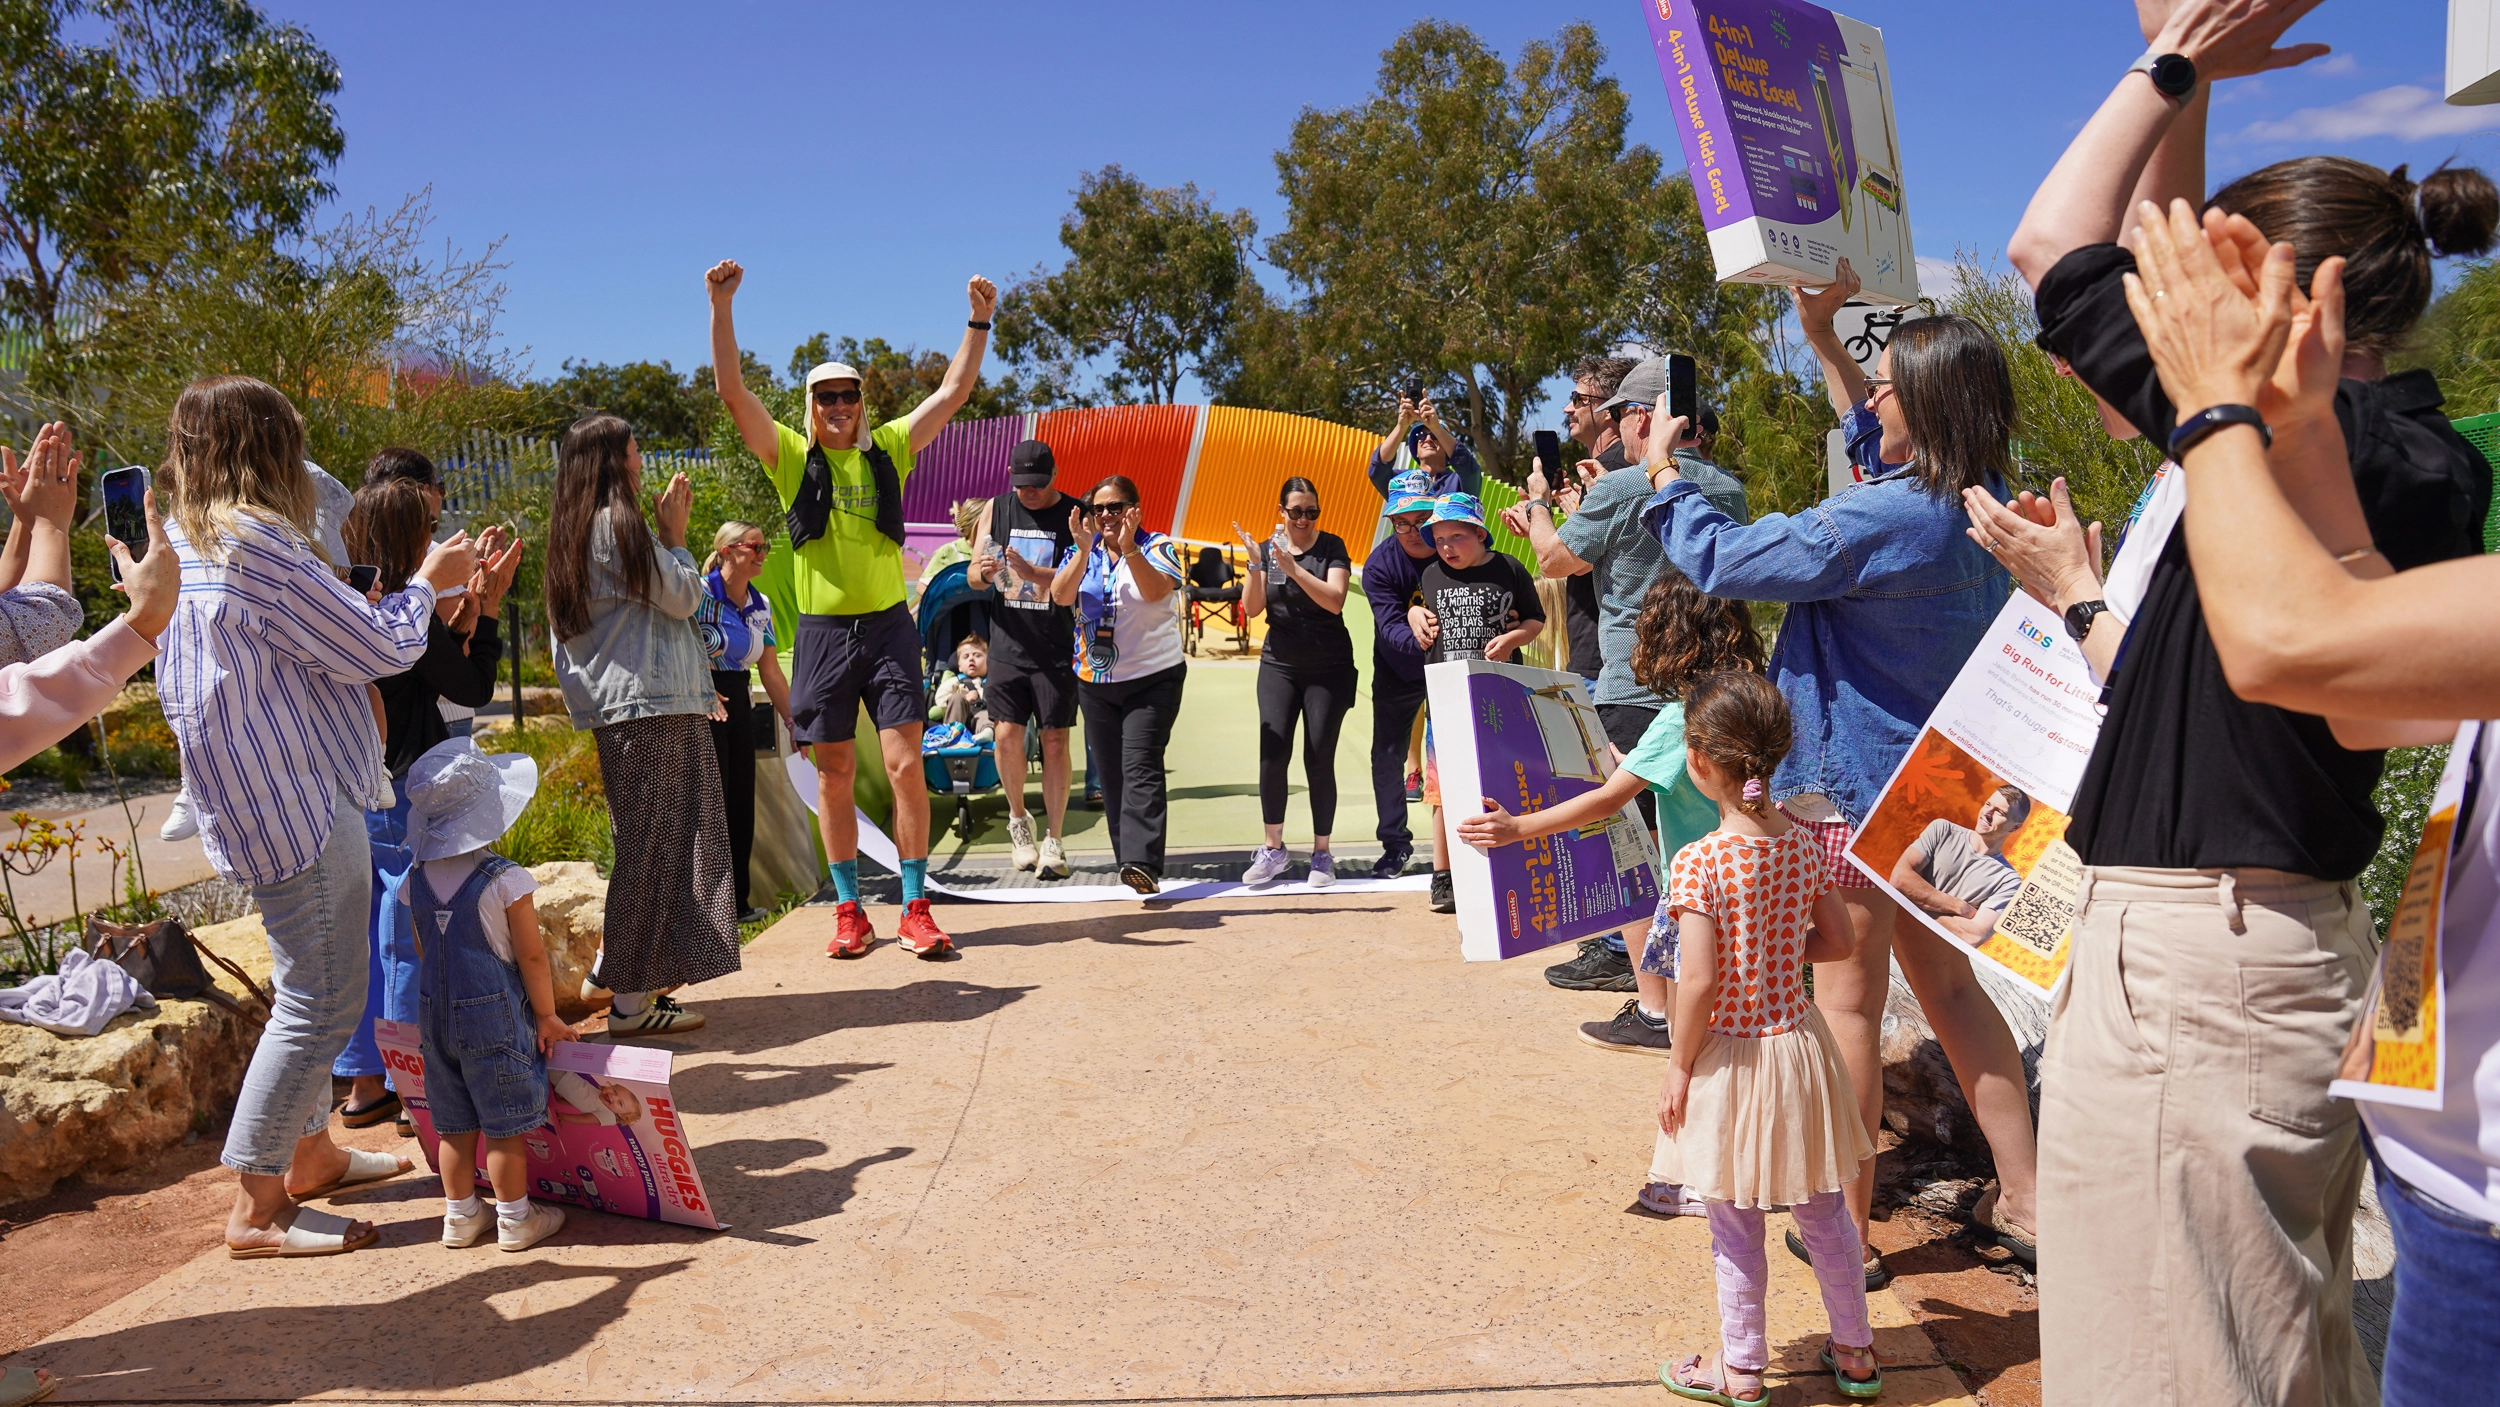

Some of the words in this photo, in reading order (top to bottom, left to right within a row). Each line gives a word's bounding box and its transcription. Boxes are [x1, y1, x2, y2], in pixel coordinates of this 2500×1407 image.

[1709, 14, 1754, 49] 4-in-1
[1714, 41, 1769, 76] Deluxe
[1722, 66, 1759, 98] Kids
[1759, 79, 1802, 112] Easel
[1667, 29, 1691, 74] 4-in-1
[1680, 74, 1705, 130] Deluxe
[1697, 130, 1716, 168] Kids
[1707, 167, 1731, 215] Easel
[1731, 100, 1764, 116] Whiteboard,
[1763, 108, 1792, 123] blackboard,
[1792, 118, 1813, 130] magnetic
[1734, 111, 1750, 122] board
[1752, 117, 1762, 125] and
[1762, 120, 1776, 130] paper
[1776, 123, 1786, 132] roll
[1786, 125, 1801, 136] holder
[1010, 528, 1057, 540] REMEMBERING
[1021, 600, 1050, 611] WATKINS
[1436, 590, 1441, 599] 3
[1444, 587, 1469, 598] YEARS
[1436, 598, 1446, 609] 36
[1449, 596, 1484, 607] MONTHS
[1438, 607, 1450, 619] 156
[1453, 606, 1481, 617] WEEKS
[1462, 616, 1483, 627] DAYS
[1470, 627, 1496, 638] HOURS
[2018, 620, 2053, 648] KIDS
[1453, 652, 1467, 660] AND
[2058, 651, 2080, 664] CANCER
[2002, 644, 2021, 663] Big
[2021, 657, 2044, 677] Run
[2045, 672, 2064, 688] for
[2064, 683, 2094, 704] Little
[1987, 668, 1999, 679] and
[1998, 676, 2028, 700] awareness
[2029, 696, 2038, 706] for
[2038, 702, 2068, 723] childhood
[1992, 660, 2011, 676] Jacob
[2011, 673, 2028, 688] Byrne
[2029, 685, 2040, 696] has
[2040, 693, 2052, 703] run
[2052, 699, 2061, 708] 30
[2062, 705, 2094, 723] marathons
[1985, 688, 2013, 712] That's
[2013, 709, 2021, 717] a
[2021, 714, 2047, 734] huge
[2047, 731, 2091, 755] distance
[1947, 728, 1957, 737] for
[1957, 736, 1981, 756] children
[1981, 753, 1996, 766] with
[1995, 762, 2012, 777] brain
[1953, 719, 1961, 728] All
[1962, 725, 1978, 741] funds
[1978, 738, 1997, 754] raised
[1997, 751, 2008, 761] will
[2008, 759, 2033, 778] support
[2033, 775, 2047, 786] new
[2047, 782, 2059, 792] and
[2060, 788, 2072, 798] bet
[1514, 760, 1537, 851] Dluxe
[1554, 834, 1562, 870] blackbo
[1566, 849, 1574, 878] holder
[2055, 846, 2062, 855] To
[2062, 851, 2078, 863] learn
[2038, 863, 2062, 878] Jacob's
[2063, 875, 2074, 885] run,
[2040, 874, 2050, 883] the
[2051, 880, 2061, 888] QR
[2060, 886, 2076, 896] code
[2066, 866, 2082, 876] supp
[1526, 858, 1544, 932] 4-in-1
[1544, 872, 1558, 929] Kids
[1558, 870, 1567, 924] Whiteboard,
[1510, 897, 1518, 931] kadink
[411, 1100, 430, 1108] napp
[628, 1138, 646, 1169] nappy
[642, 1167, 656, 1197] pants
[646, 1097, 706, 1212] HUGGIES
[540, 1180, 549, 1191] 5
[579, 1169, 591, 1178] 5
[653, 1153, 671, 1183] ultra
[666, 1185, 681, 1208] dry
